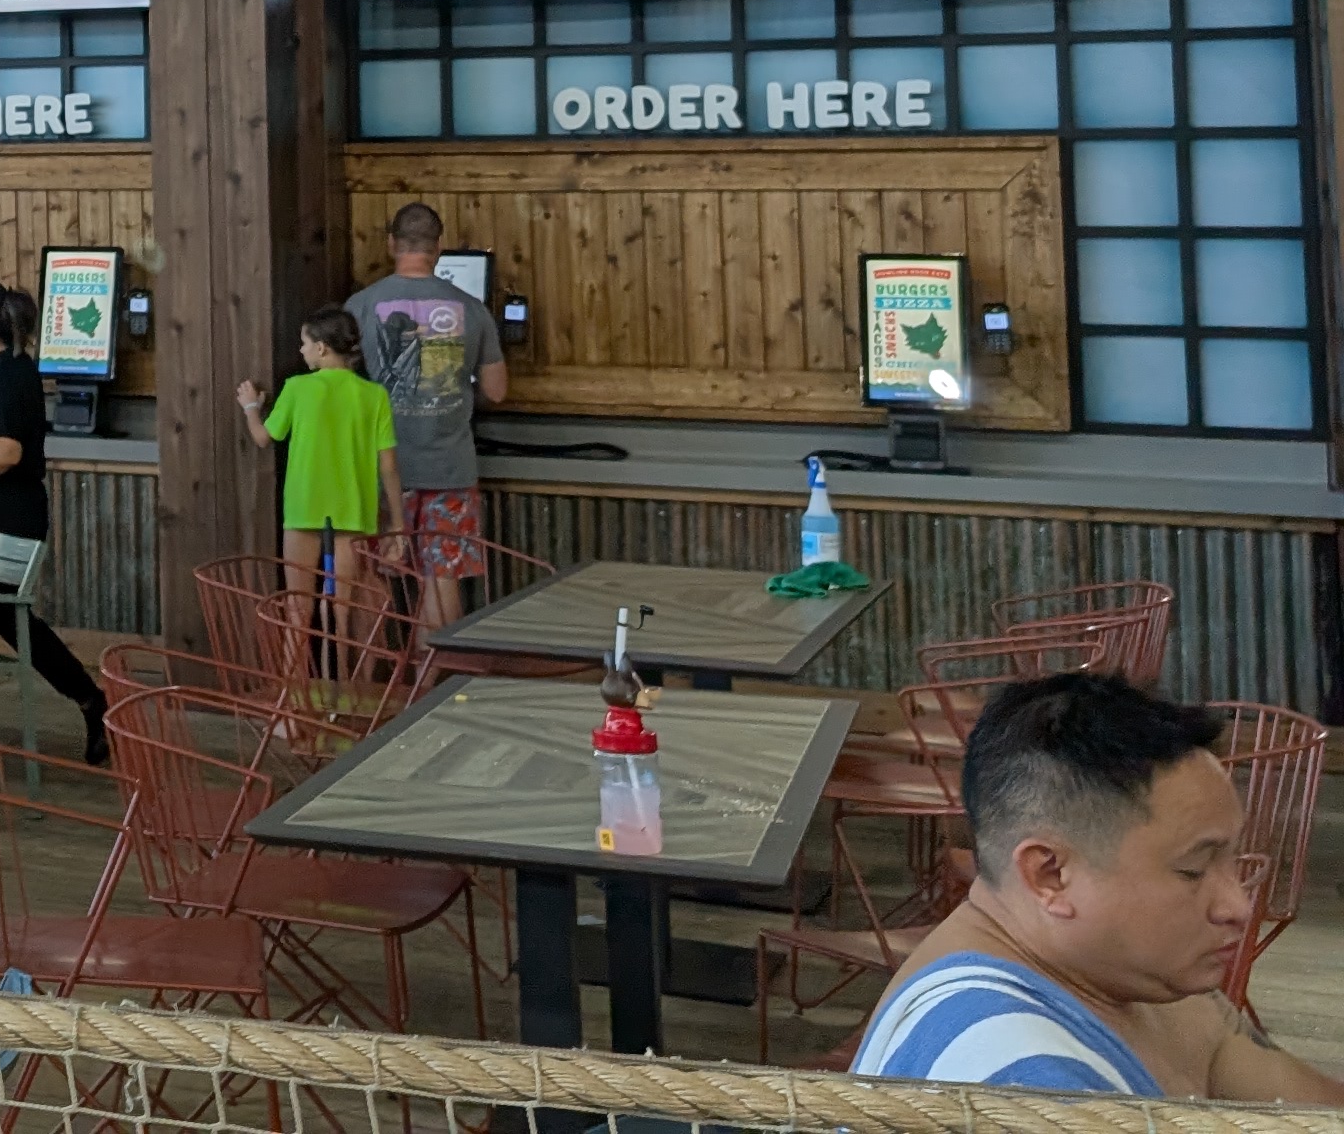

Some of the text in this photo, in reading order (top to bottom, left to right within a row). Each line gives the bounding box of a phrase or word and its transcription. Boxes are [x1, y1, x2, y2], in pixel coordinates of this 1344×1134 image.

[552, 79, 932, 131] ORDER HERE
[52, 273, 106, 283] BURGERS
[56, 285, 102, 294] PIZZA
[876, 284, 948, 296] BURGERS
[881, 298, 945, 308] PIZZA
[44, 295, 54, 345] TACOS
[885, 311, 897, 358] SNACKS
[873, 311, 883, 368] TACOS
